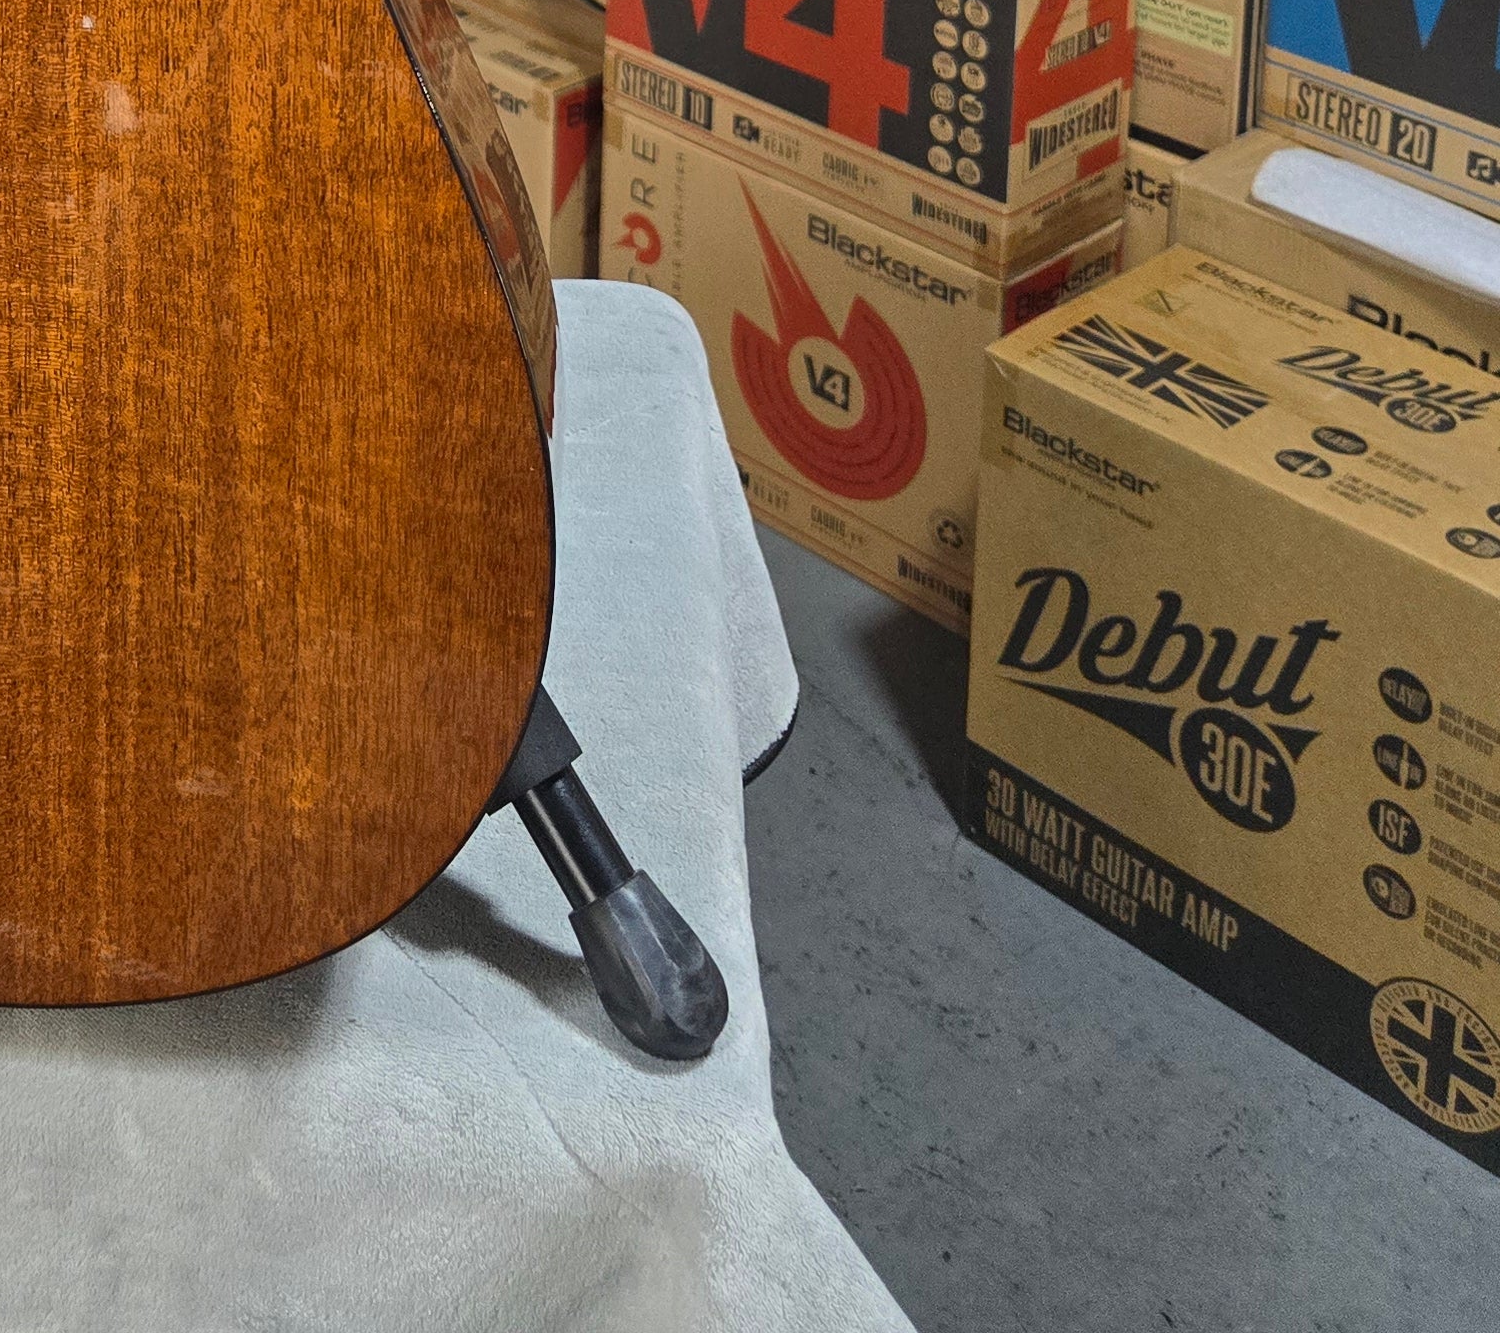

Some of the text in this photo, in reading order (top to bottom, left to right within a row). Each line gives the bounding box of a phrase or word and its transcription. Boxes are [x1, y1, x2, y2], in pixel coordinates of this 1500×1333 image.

[620, 60, 677, 119] STEREO
[687, 89, 709, 128] 10
[1029, 88, 1118, 173] WIDESTEREO
[1296, 81, 1429, 165] STEREO 20
[807, 213, 968, 306] Blackstar
[1195, 262, 1336, 325] Blackstar
[803, 354, 850, 413] V4
[1003, 406, 1155, 495] Blackstar
[997, 567, 1342, 715] Debut
[1201, 722, 1277, 824] 30E
[985, 806, 1139, 928] WITH DELAY EFFECT
[987, 768, 1238, 952] 30 WATT GUITAR AMP
[1379, 804, 1411, 849] ISF
